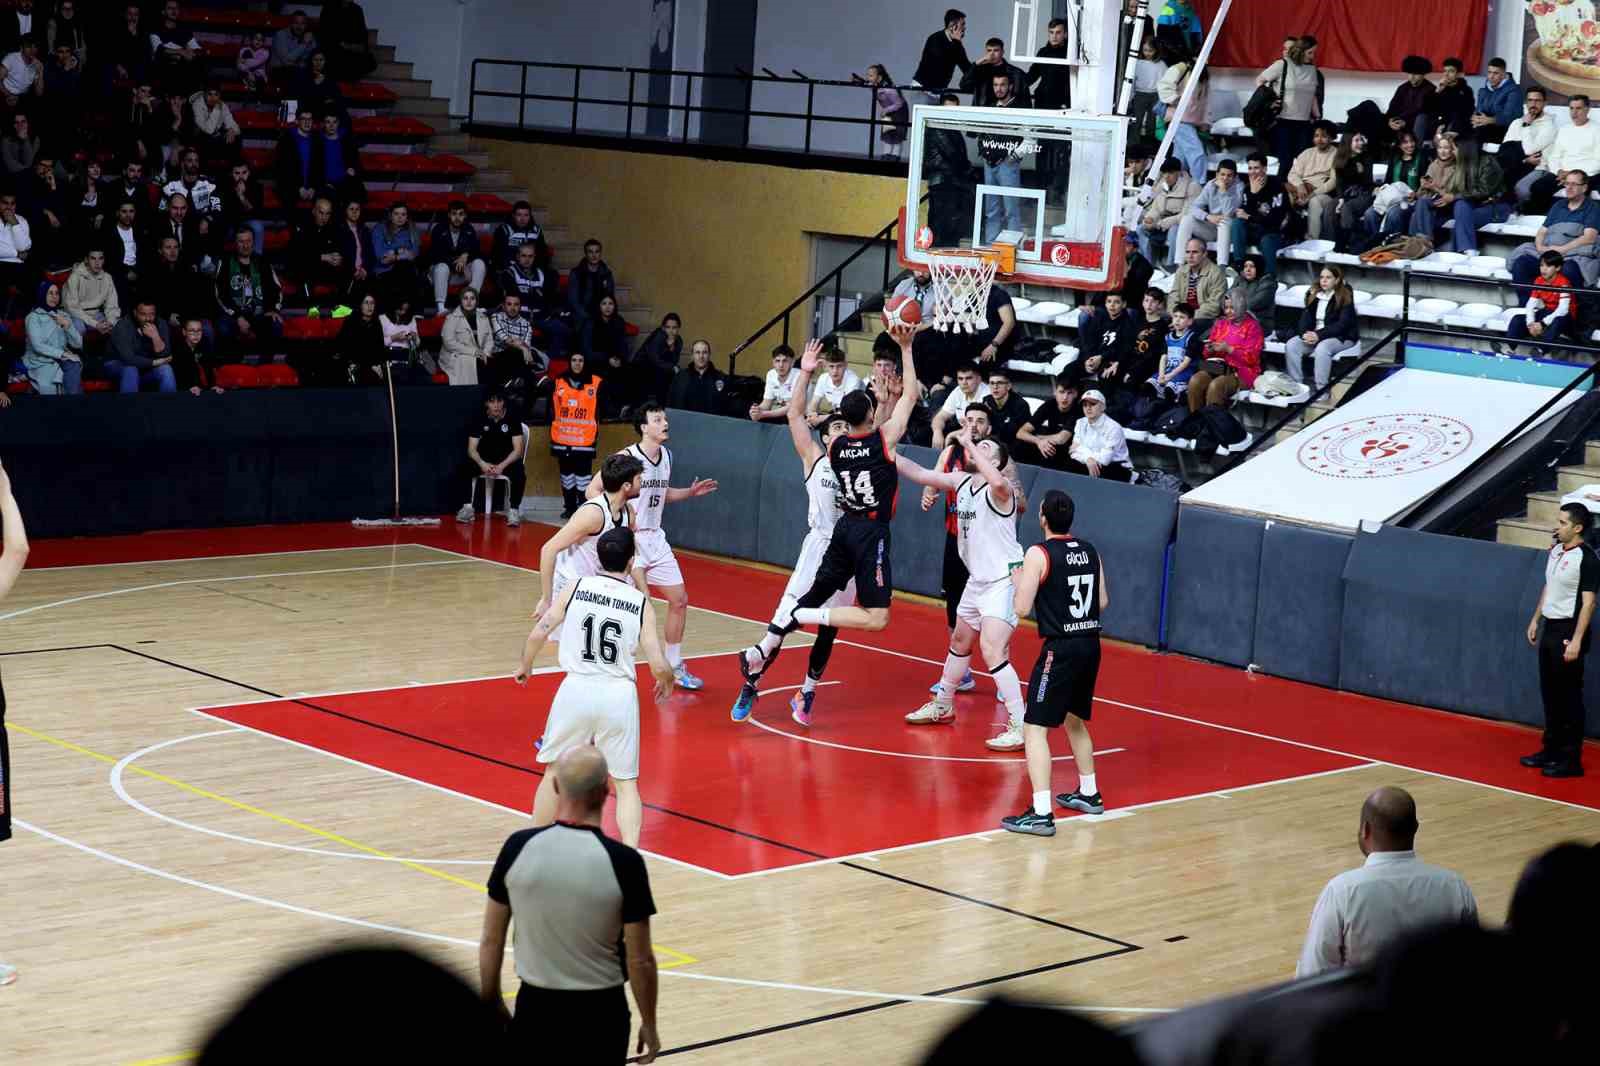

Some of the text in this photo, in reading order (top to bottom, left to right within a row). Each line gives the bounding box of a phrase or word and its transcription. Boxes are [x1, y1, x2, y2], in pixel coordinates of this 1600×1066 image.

[839, 447, 870, 460] AKÇAM
[840, 470, 875, 505] 14
[648, 495, 661, 508] 15
[1066, 551, 1089, 567] GÜÇLÜ
[1067, 574, 1095, 619] 37
[612, 598, 641, 616] TOKMAK
[581, 613, 623, 665] 16
